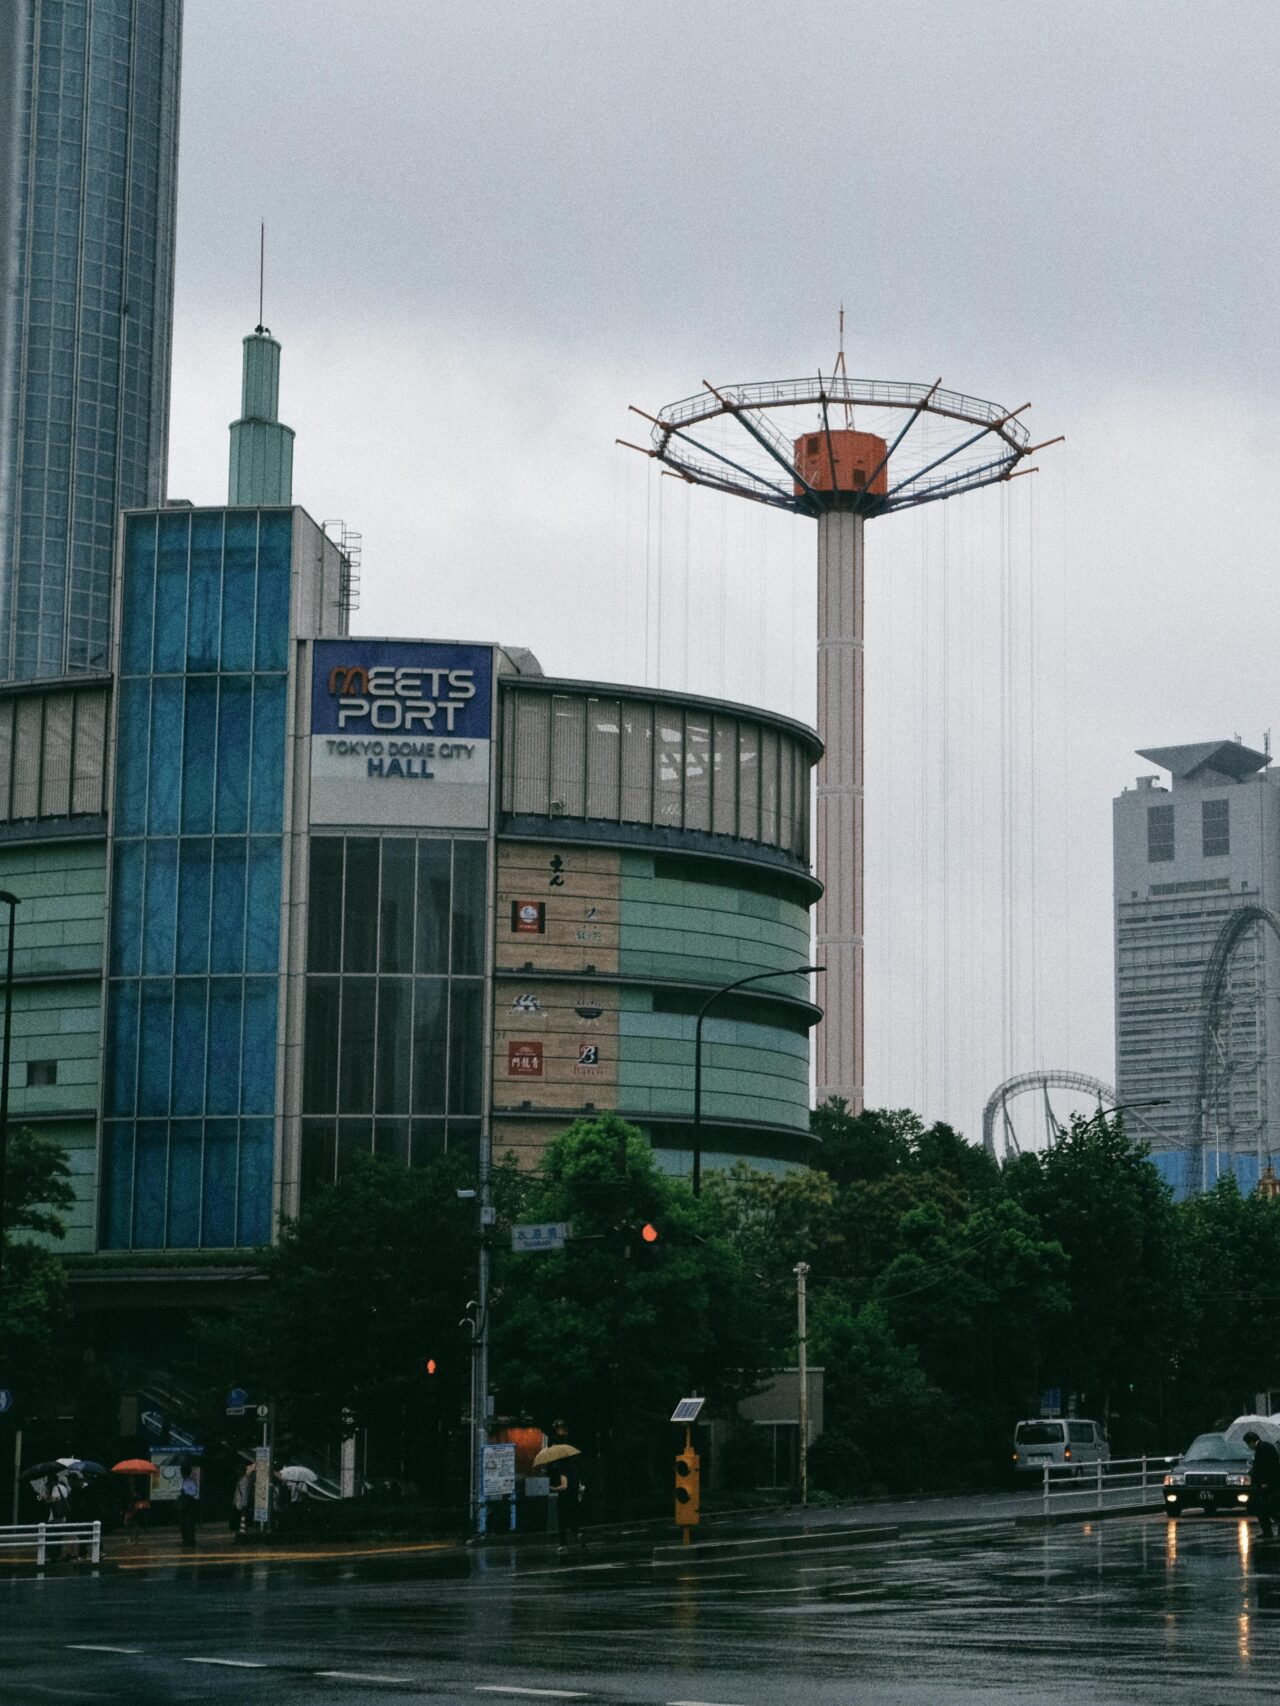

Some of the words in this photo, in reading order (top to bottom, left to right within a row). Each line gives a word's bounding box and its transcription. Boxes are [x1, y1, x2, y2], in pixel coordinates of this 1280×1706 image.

[338, 698, 465, 731] PORT
[326, 740, 384, 757] TOKYO
[388, 742, 436, 758] DOME
[439, 744, 475, 759] CITY
[367, 758, 434, 779] HALL
